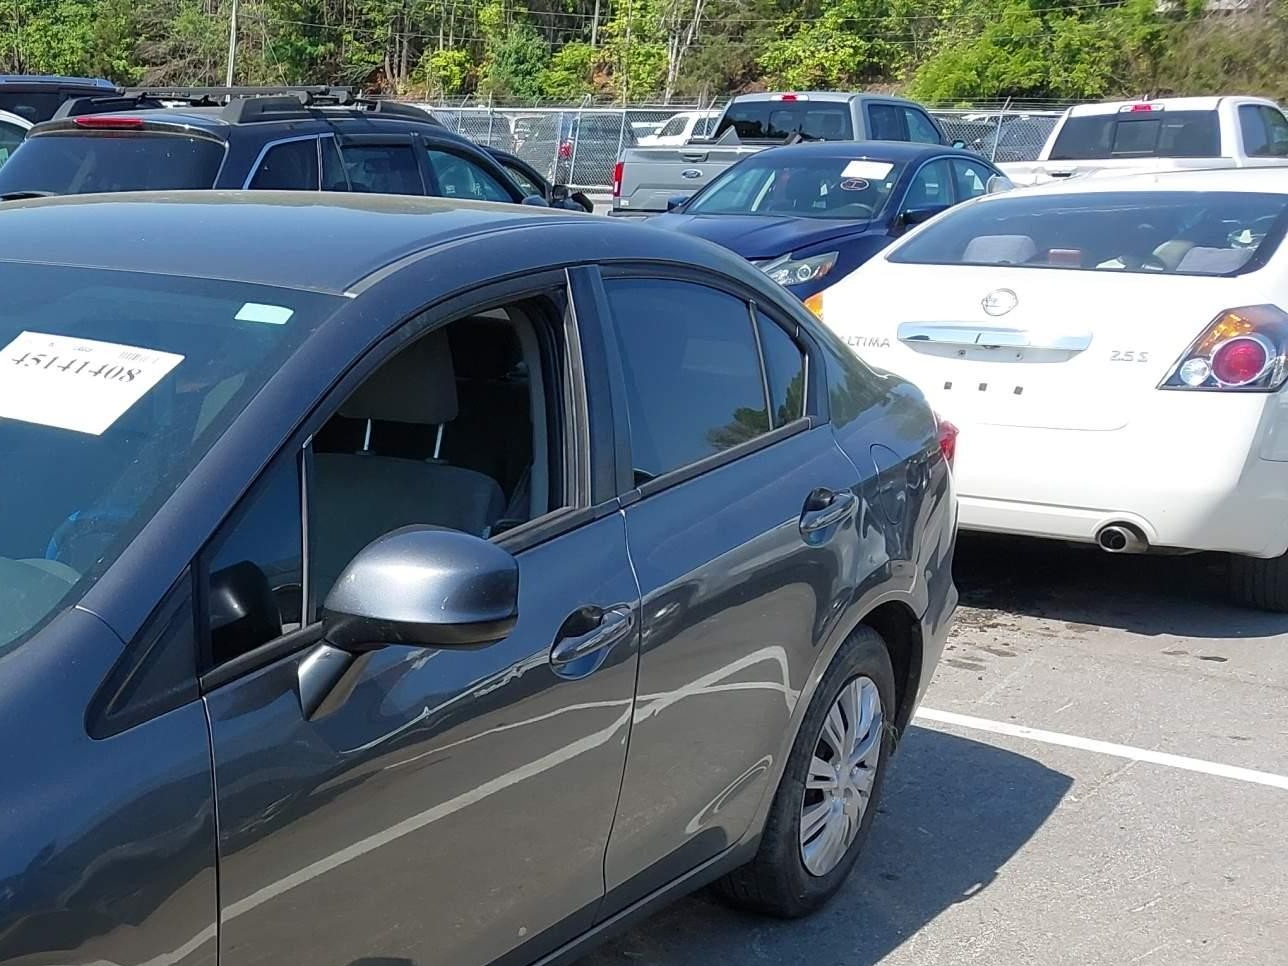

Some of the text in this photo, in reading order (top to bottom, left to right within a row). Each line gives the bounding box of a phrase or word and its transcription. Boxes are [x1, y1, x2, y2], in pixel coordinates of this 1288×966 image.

[840, 335, 890, 349] LTIMA
[1110, 350, 1134, 362] 2.5
[11, 352, 142, 382] 45141408
